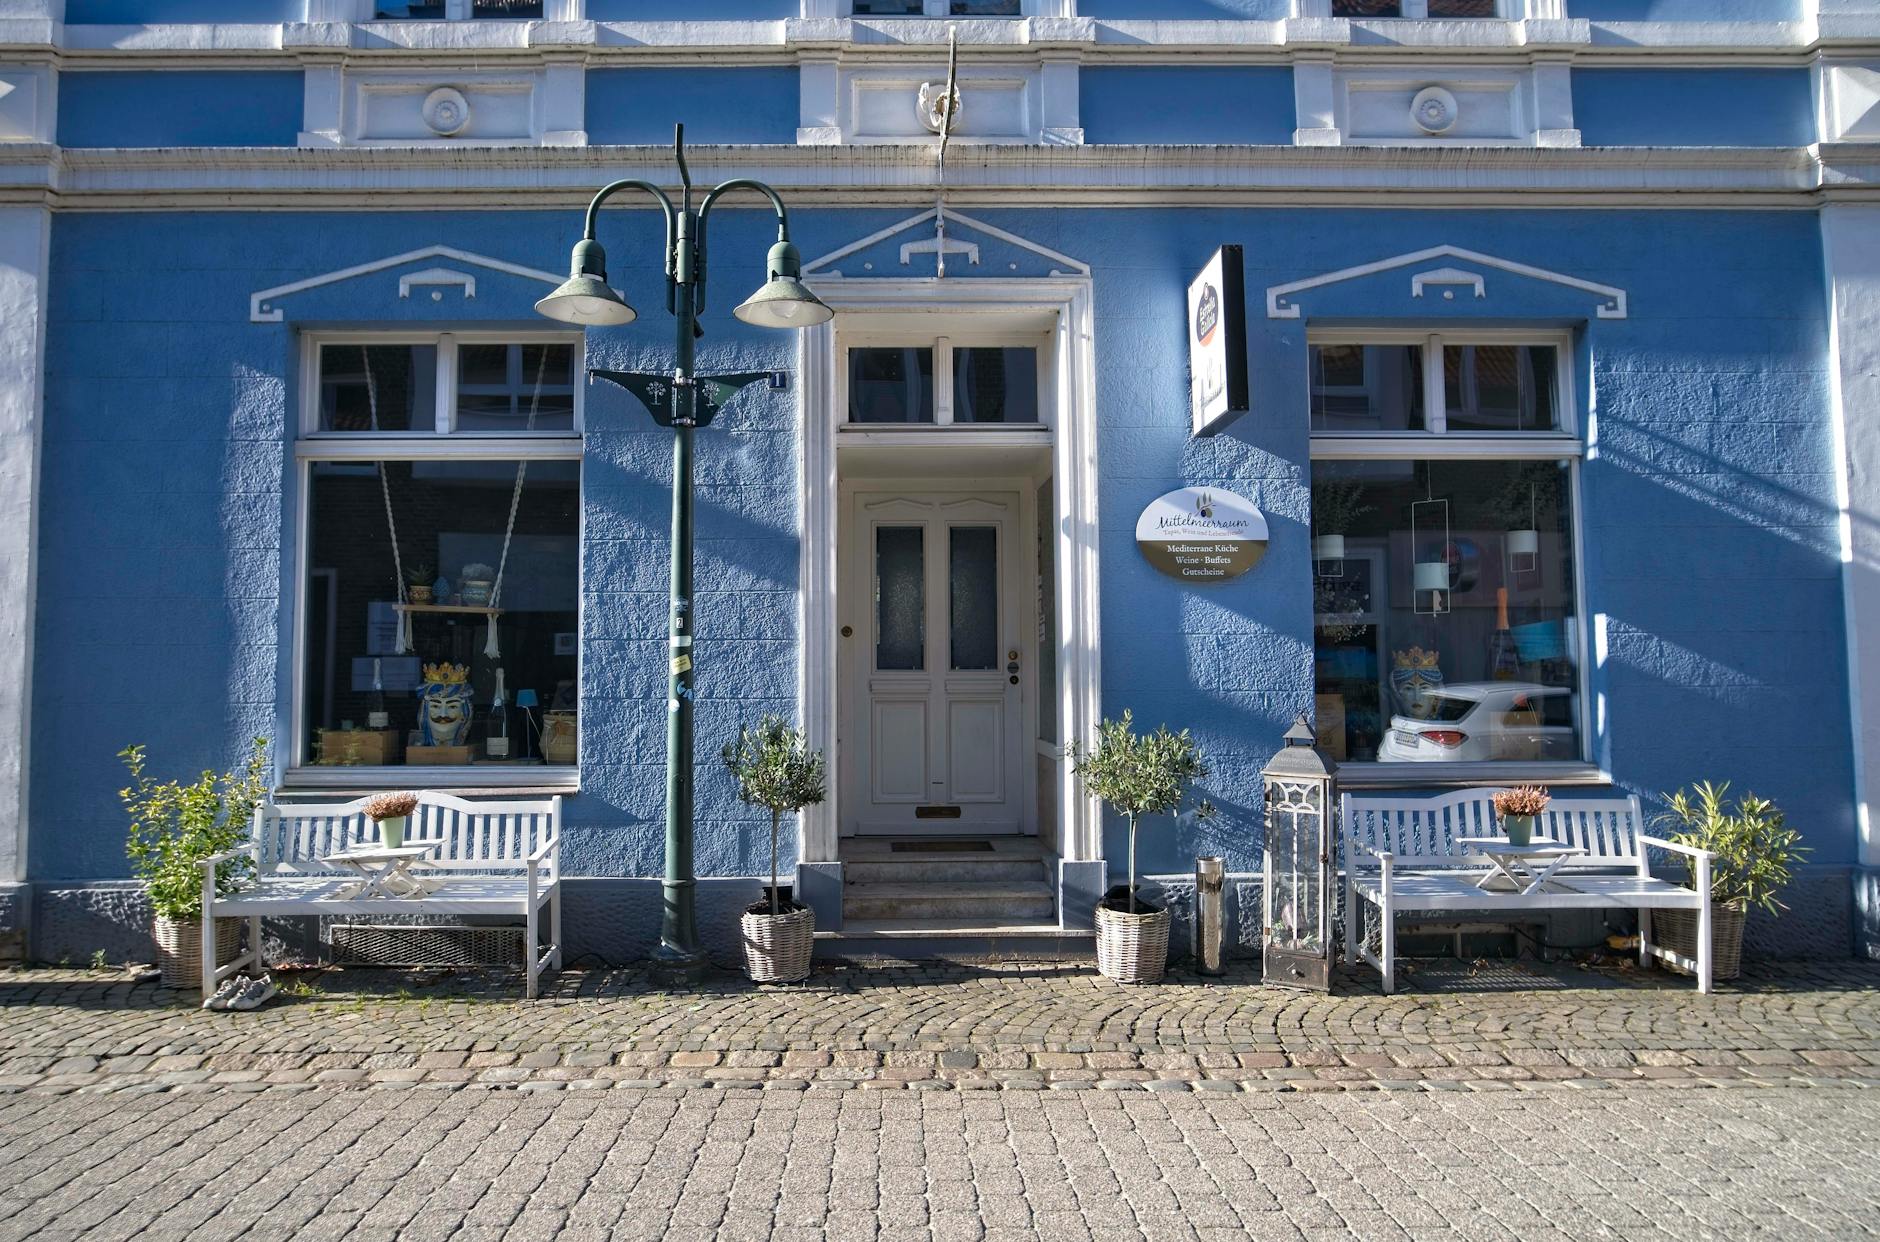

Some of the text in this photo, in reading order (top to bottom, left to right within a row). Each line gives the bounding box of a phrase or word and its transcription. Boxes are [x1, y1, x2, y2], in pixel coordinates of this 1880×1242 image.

[1199, 296, 1215, 323] Estrella
[1200, 311, 1216, 337] Galicia
[774, 372, 781, 387] 1
[1155, 512, 1250, 529] Mittelmeerraum
[1167, 544, 1239, 553] Mediterrane Küche
[1175, 555, 1231, 564] Weine Buffets
[1182, 567, 1225, 576] Gutscheine
